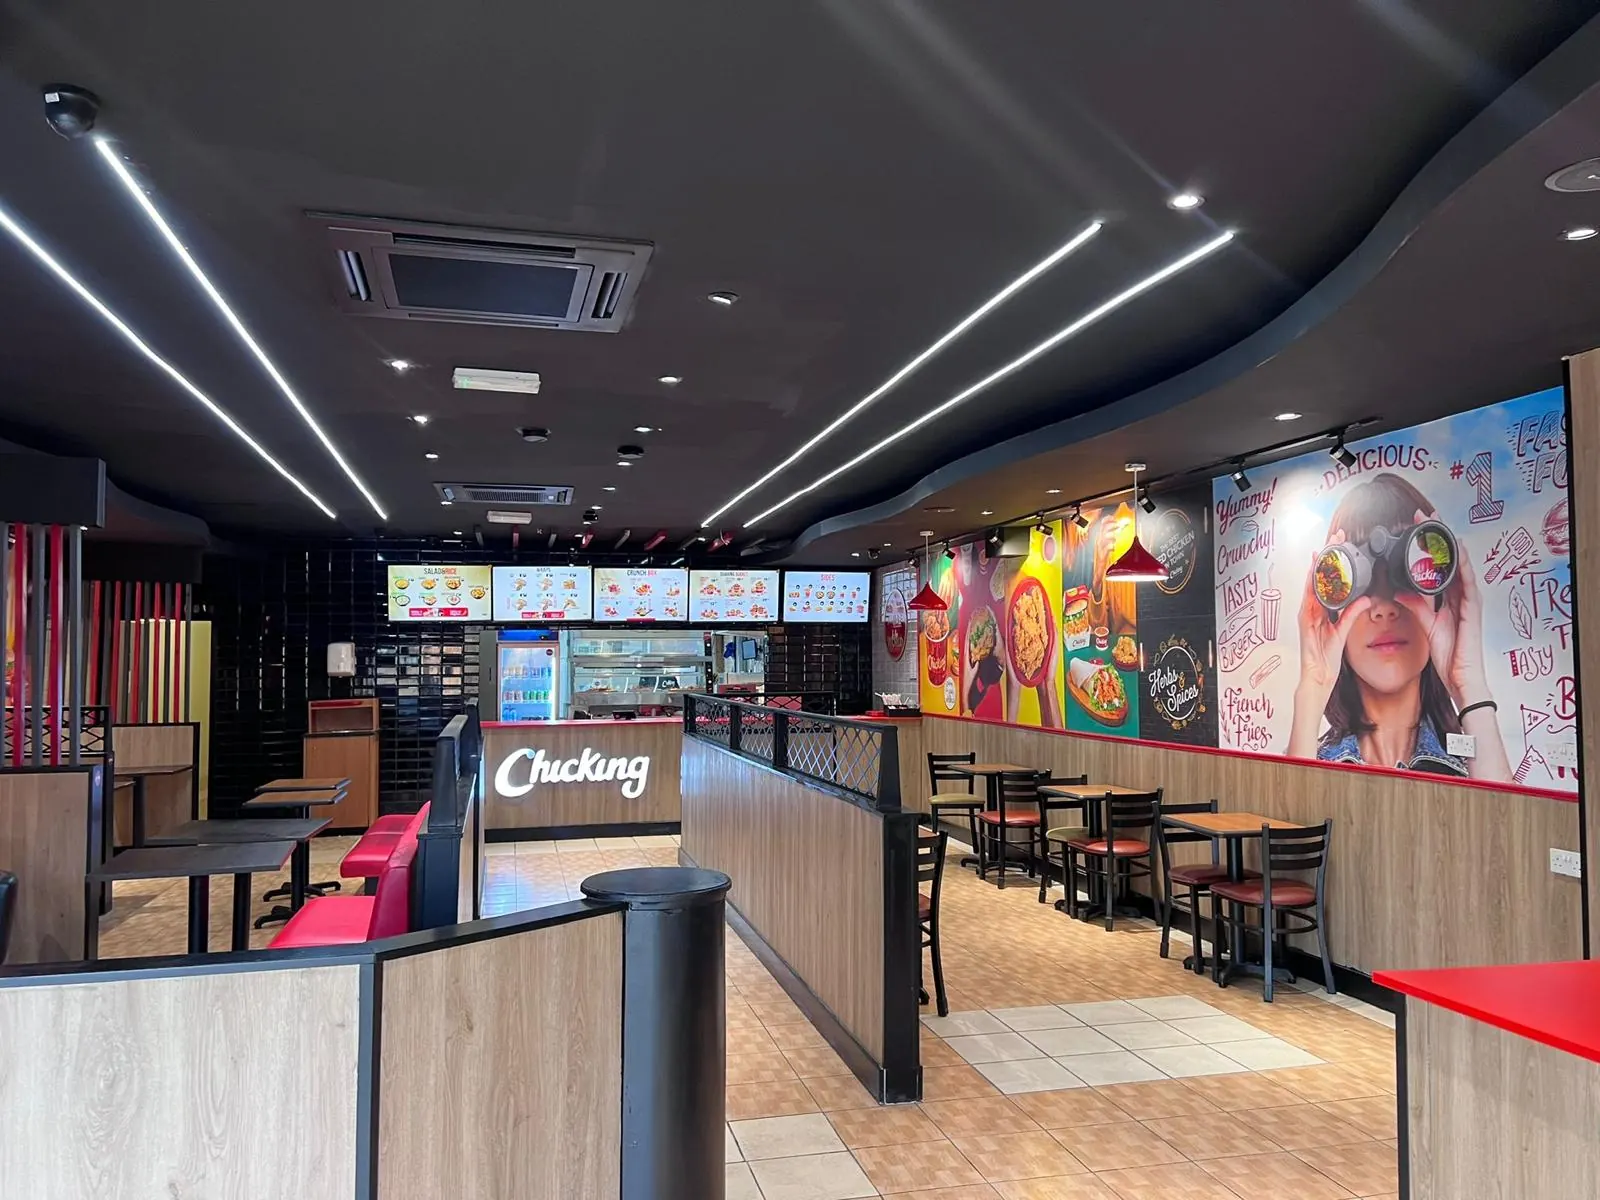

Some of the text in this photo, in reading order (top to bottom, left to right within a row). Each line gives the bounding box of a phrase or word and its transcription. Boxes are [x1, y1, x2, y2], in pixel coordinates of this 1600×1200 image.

[1216, 477, 1278, 535] Yummy!
[1166, 530, 1195, 558] CHICKEN
[1217, 518, 1275, 575] Crunchy!
[1215, 572, 1258, 617] TASTY
[1503, 644, 1554, 682] TASTY
[1148, 666, 1178, 697] Herbs
[1166, 684, 1199, 712] Spices
[1224, 687, 1274, 721] French
[1233, 714, 1273, 749] Fries
[494, 747, 651, 799] Chicking
